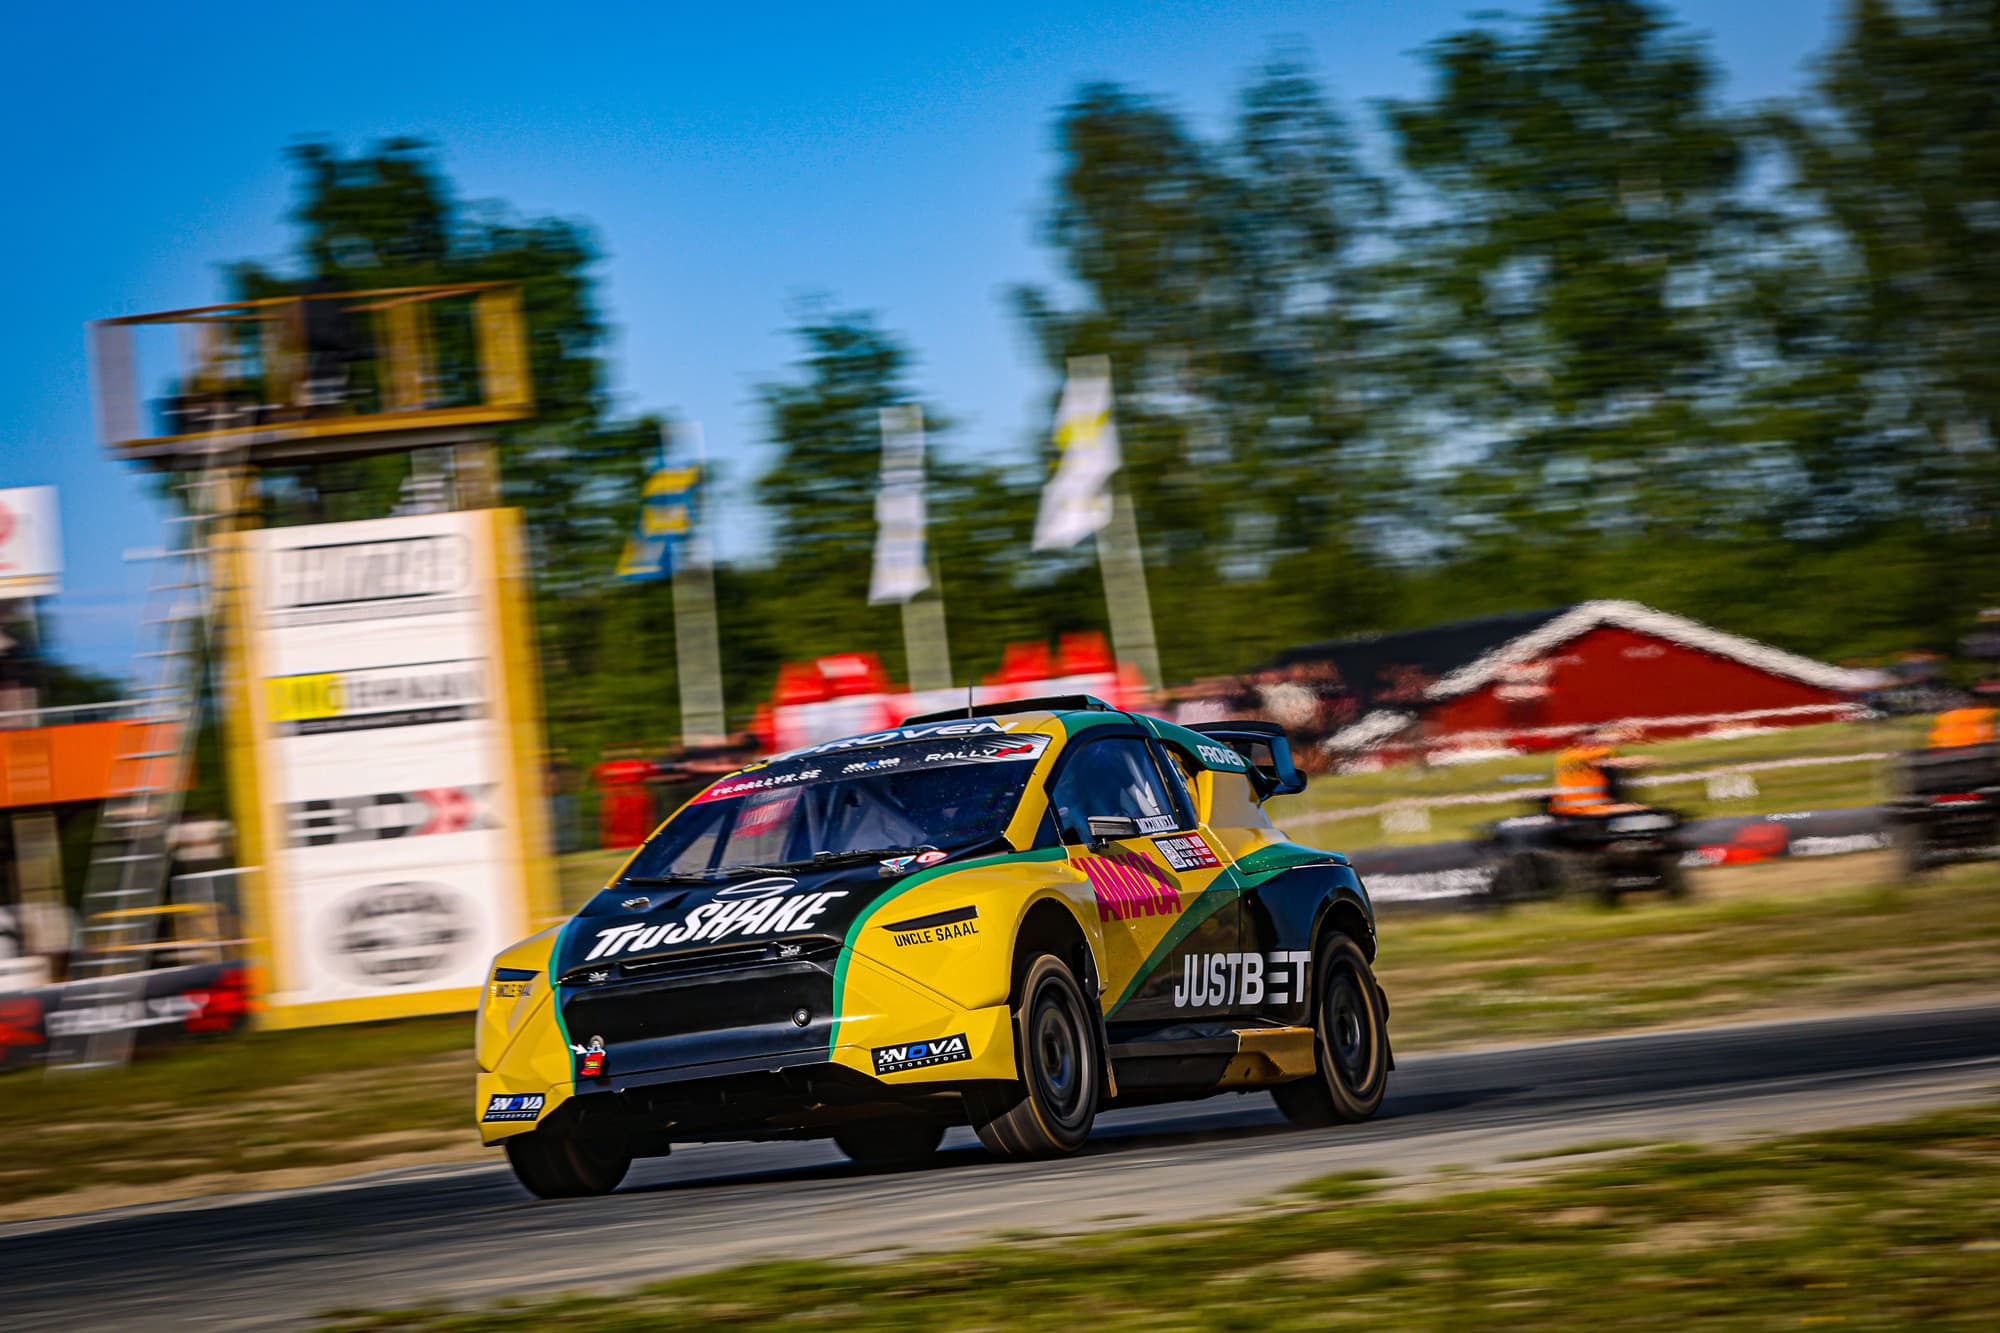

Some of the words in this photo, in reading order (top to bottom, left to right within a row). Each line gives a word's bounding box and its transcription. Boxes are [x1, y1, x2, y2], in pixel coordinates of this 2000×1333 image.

[1195, 744, 1246, 767] PROVEN
[1070, 851, 1183, 923] AMAICA
[893, 930, 933, 947] UNCLE
[935, 920, 980, 942] SAAAL
[1174, 950, 1312, 1008] JUSTBET
[878, 1037, 966, 1065] NOVA
[878, 1052, 968, 1073] MOTORSPORT
[488, 1096, 545, 1111] NOVA
